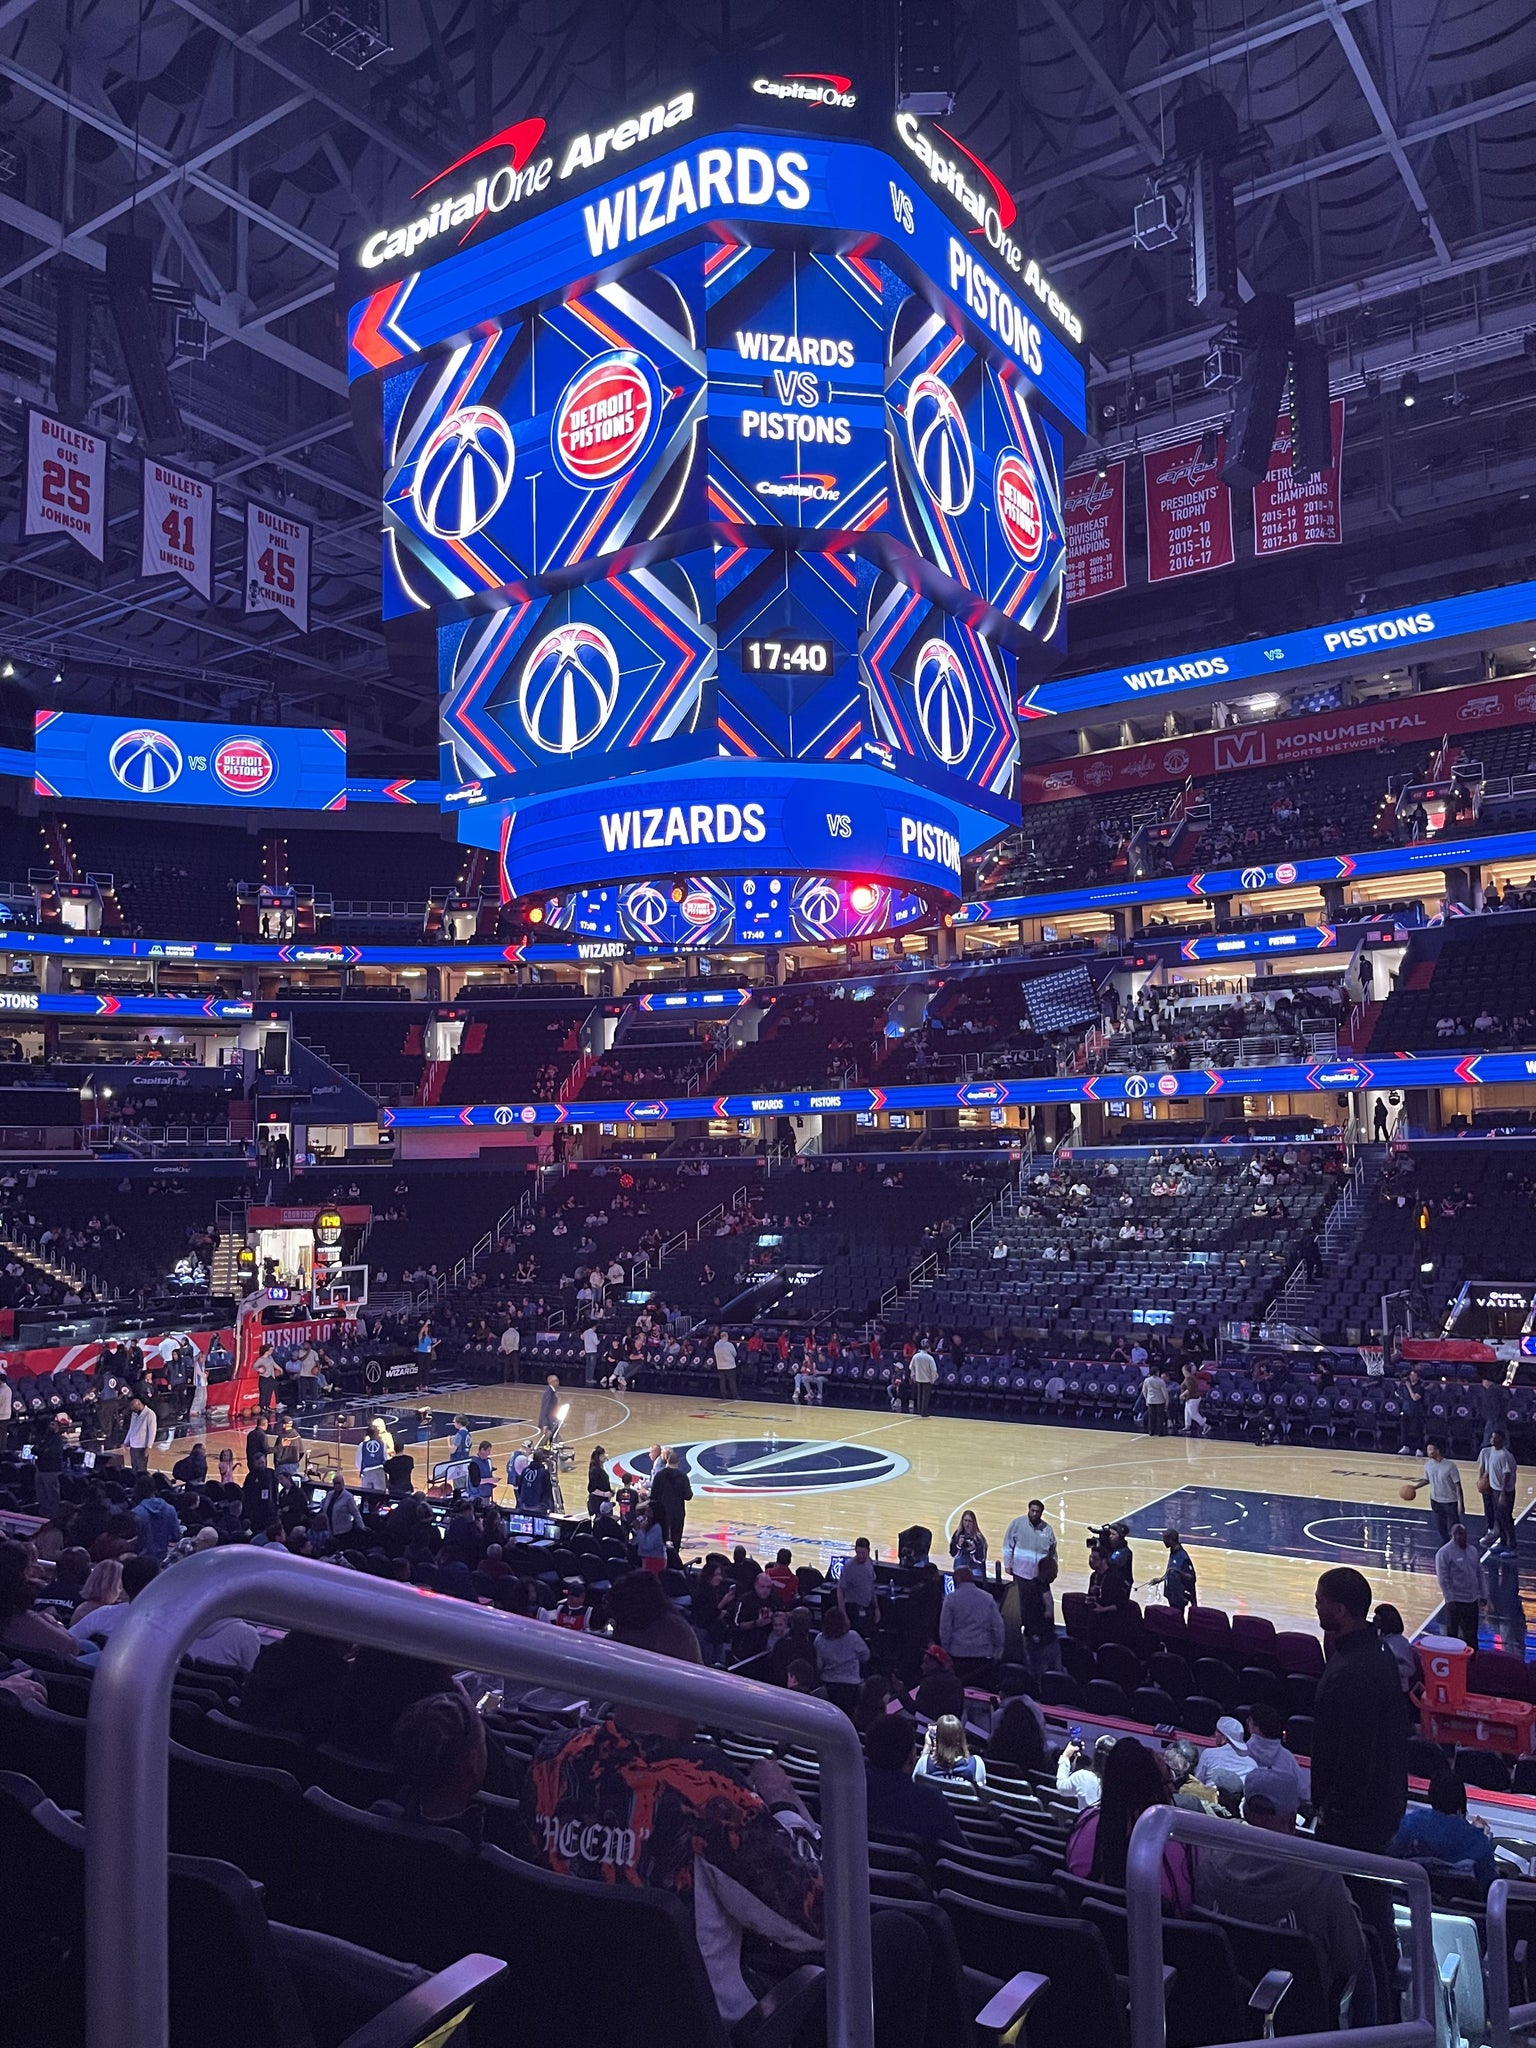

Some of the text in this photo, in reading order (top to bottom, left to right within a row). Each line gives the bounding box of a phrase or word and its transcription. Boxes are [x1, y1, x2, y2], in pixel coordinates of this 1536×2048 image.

[560, 92, 695, 180] Arena
[583, 148, 1043, 376] WIZARDS VS PISTONS
[1024, 260, 1083, 344] Arena
[736, 331, 855, 368] WIZARDS
[773, 369, 819, 408] VS
[569, 388, 634, 431] DETROIT
[41, 419, 95, 453] BULLETS
[570, 410, 635, 452] PISTONS
[742, 411, 852, 445] PISTONS
[57, 447, 79, 465] GUS
[42, 459, 91, 515] 25
[155, 467, 203, 498] BULLETS
[1270, 483, 1328, 505] CHAMPIONS
[169, 492, 189, 509] WES
[40, 505, 91, 534] JOHNSON
[1171, 503, 1206, 522] TROPHY
[1261, 506, 1296, 523] 2015-16
[162, 509, 195, 555] 41
[257, 510, 300, 539] BULLETS
[1168, 520, 1211, 542] 2009-10
[1262, 519, 1297, 536] 2016-17
[269, 533, 289, 551] PHIL
[1066, 538, 1110, 558] HAMPIONS
[1069, 529, 1104, 547] DIVISION
[1169, 535, 1211, 557] 2015-16
[1262, 532, 1298, 549] 2017-18
[159, 549, 195, 573] UNSELD
[257, 548, 296, 593] 45
[1169, 550, 1212, 572] 2016-17
[747, 641, 829, 674] 17:40
[1123, 657, 1229, 692] WIZARDS
[1324, 613, 1435, 652] PISTONS
[1275, 713, 1427, 750] MONUMENTAL
[1276, 735, 1385, 761] SPORTS NETWORK
[188, 756, 207, 771] VS
[223, 755, 263, 768] DETROIT
[223, 765, 264, 777] PISTONS
[600, 802, 766, 853] WIZARDS
[826, 813, 852, 838] VS
[578, 943, 627, 959] WIZARD
[752, 1098, 784, 1111] WIZARDS
[810, 1096, 841, 1108] PISTONS
[1476, 1298, 1533, 1308] VAULT
[385, 1366, 419, 1378] WIZARDS
[1431, 1657, 1450, 1677] G
